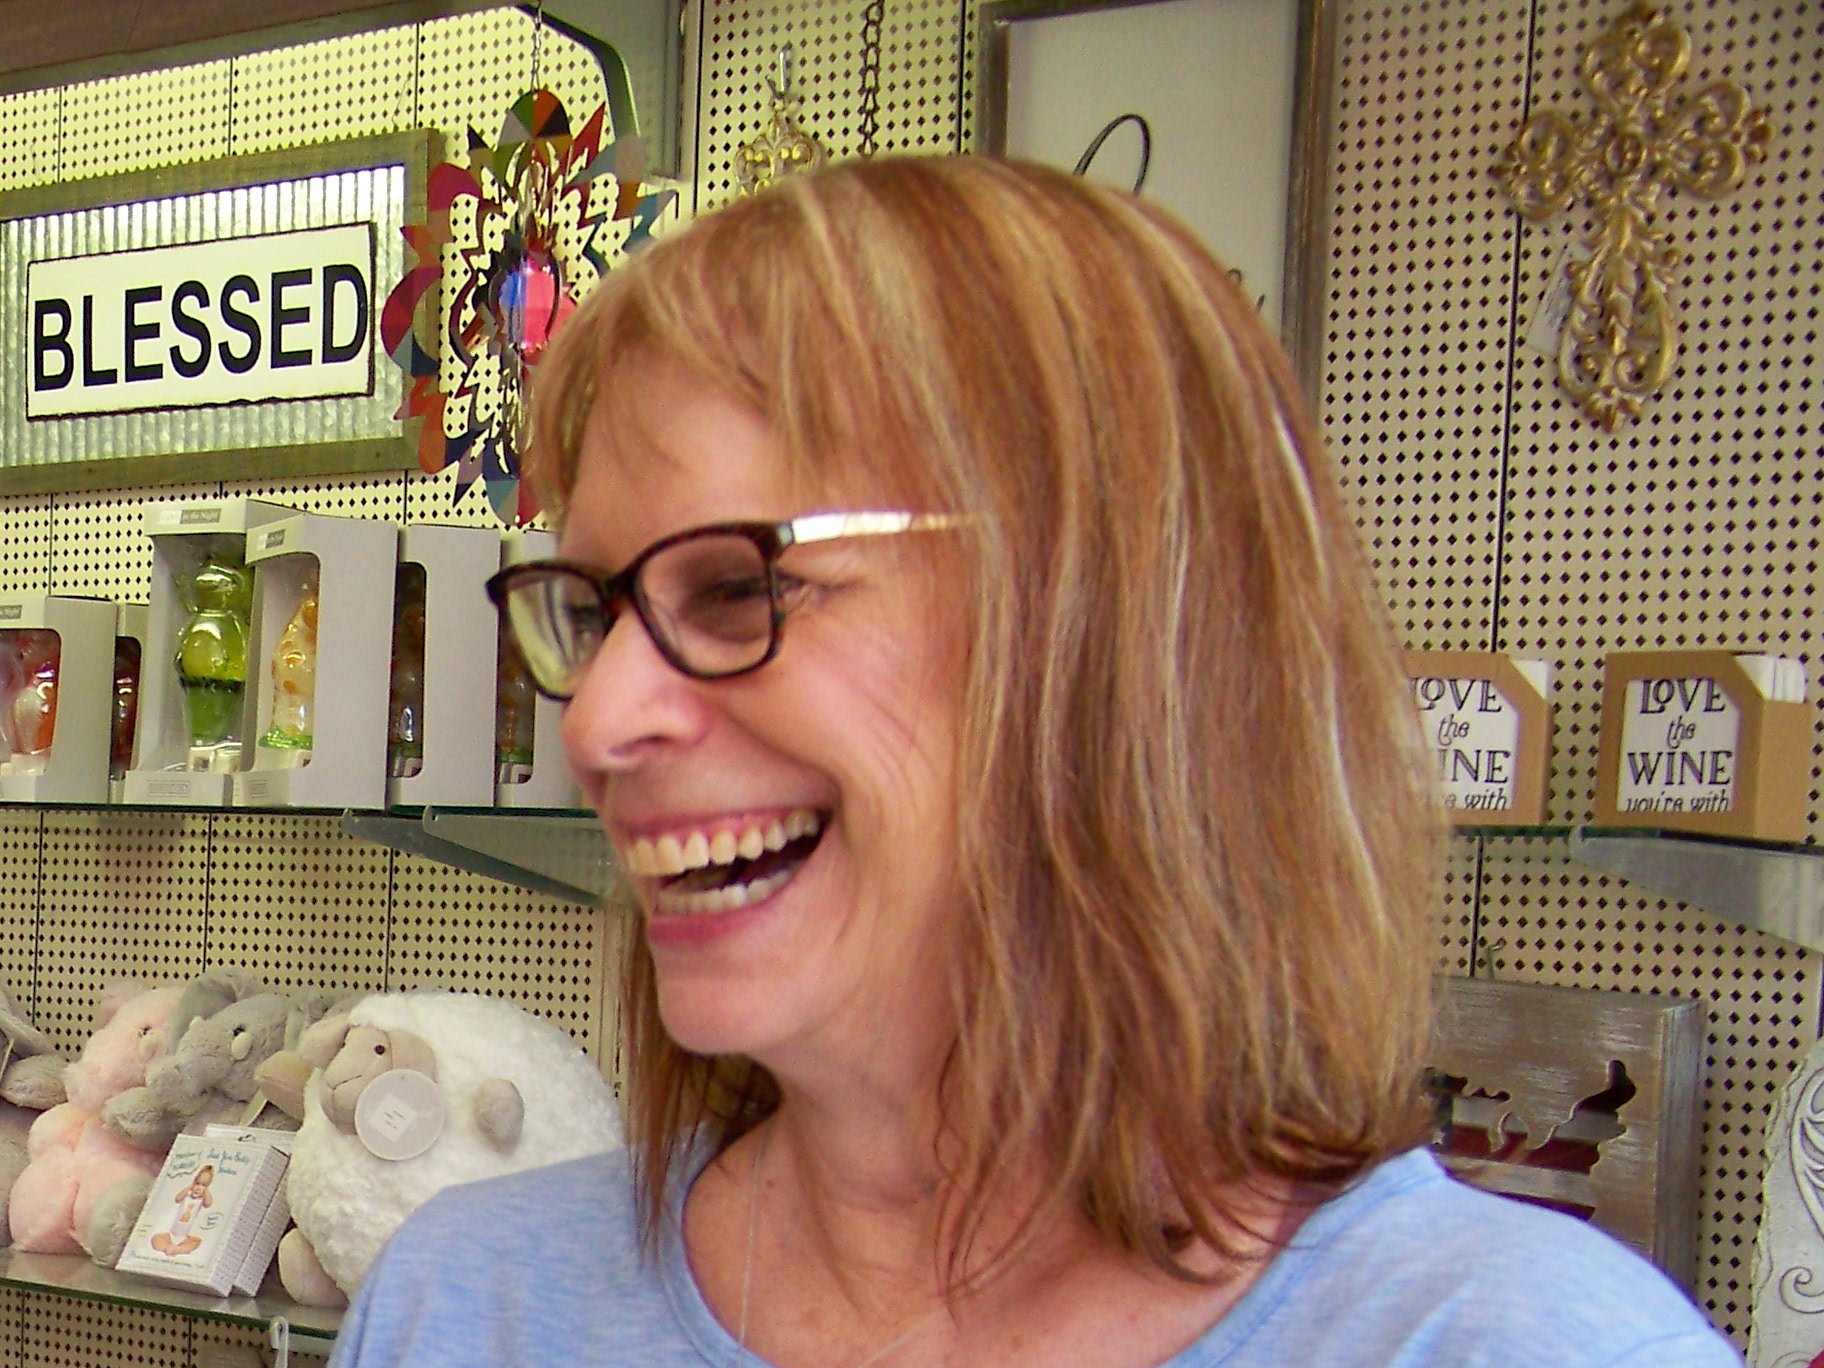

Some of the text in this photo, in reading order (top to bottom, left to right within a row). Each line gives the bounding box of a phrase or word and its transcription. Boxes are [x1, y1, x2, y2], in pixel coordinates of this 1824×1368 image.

[32, 264, 368, 393] BLESSED
[1639, 677, 1726, 714] LOVE
[1437, 713, 1470, 747] the
[1666, 715, 1696, 749] the
[1437, 748, 1511, 783] INE
[1627, 750, 1733, 785] WINE
[1464, 788, 1508, 811] with
[1690, 788, 1729, 812] with
